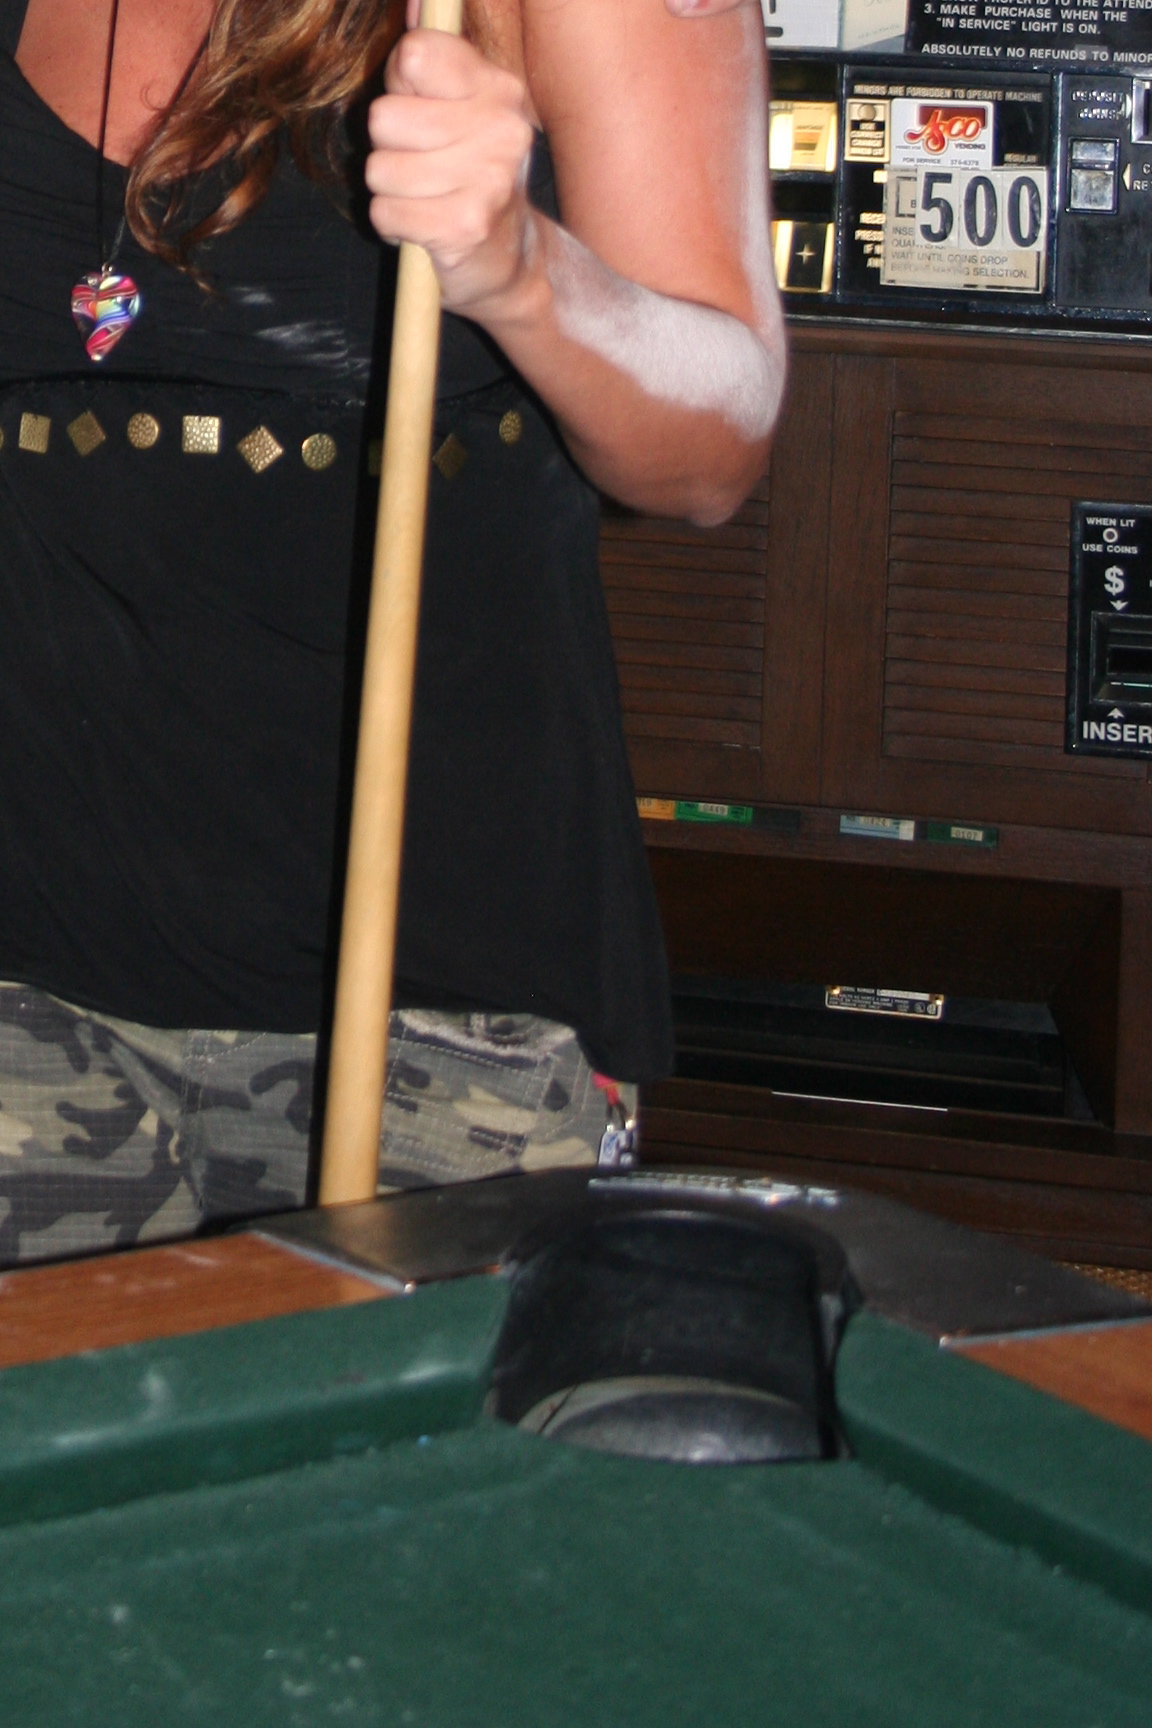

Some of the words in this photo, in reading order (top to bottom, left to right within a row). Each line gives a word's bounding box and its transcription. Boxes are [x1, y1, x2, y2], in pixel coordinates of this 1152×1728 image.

[923, 3, 936, 15] 3.
[939, 3, 976, 16] MAKE
[984, 5, 1051, 19] PURCHASE
[1060, 9, 1098, 21] WHEN
[1102, 10, 1127, 23] THE
[936, 17, 954, 28] "IN
[958, 18, 1016, 31] SERVICE"
[1021, 21, 1058, 33] LIGHT
[1062, 22, 1074, 34] IS
[1078, 23, 1101, 35] ON.
[921, 42, 1002, 58] ABSOLUTELY
[1006, 46, 1026, 59] NO
[1029, 47, 1087, 61] REFUNDS
[1091, 50, 1109, 62] TO
[853, 84, 888, 96] MINORS
[888, 85, 905, 97] ARE
[906, 86, 952, 99] FORBIDDEN
[953, 88, 965, 99] TO
[966, 88, 1003, 101] OPERATE
[1005, 91, 1043, 103] MACHINE
[1133, 180, 1152, 191] RE
[919, 171, 1043, 248] 500
[891, 250, 914, 261] WAIT
[917, 252, 943, 262] UNTIL
[947, 254, 977, 264] COINS
[980, 255, 1008, 266] DROP
[973, 267, 1029, 280] SELECTION.
[1085, 516, 1116, 527] WHEN
[1120, 517, 1136, 528] LIT
[1082, 543, 1103, 553] USE
[1106, 544, 1138, 555] COINS
[1103, 564, 1125, 596] $
[1082, 720, 1152, 744] INSER
